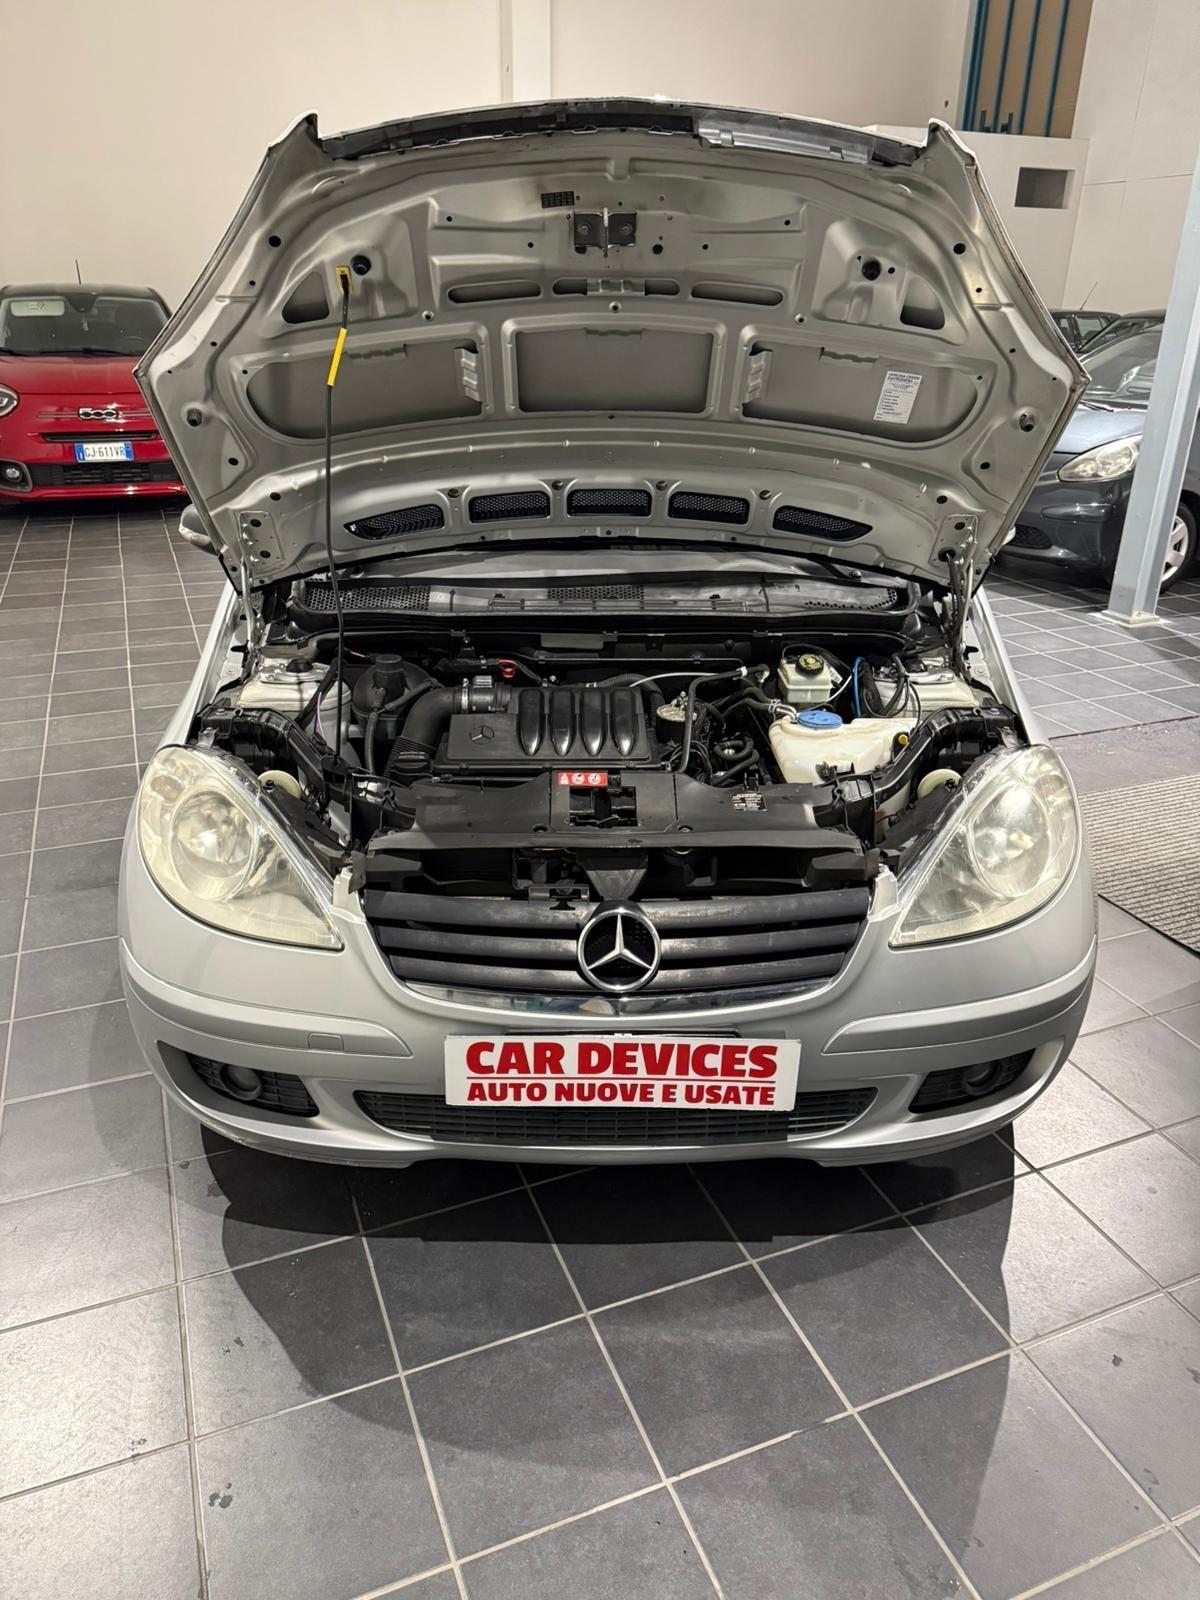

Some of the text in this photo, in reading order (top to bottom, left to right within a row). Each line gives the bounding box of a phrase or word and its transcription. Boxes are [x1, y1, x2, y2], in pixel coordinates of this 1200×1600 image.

[466, 1041, 778, 1079] CAR DEVICES
[467, 1082, 776, 1106] AUTO NUOVE E USATE
